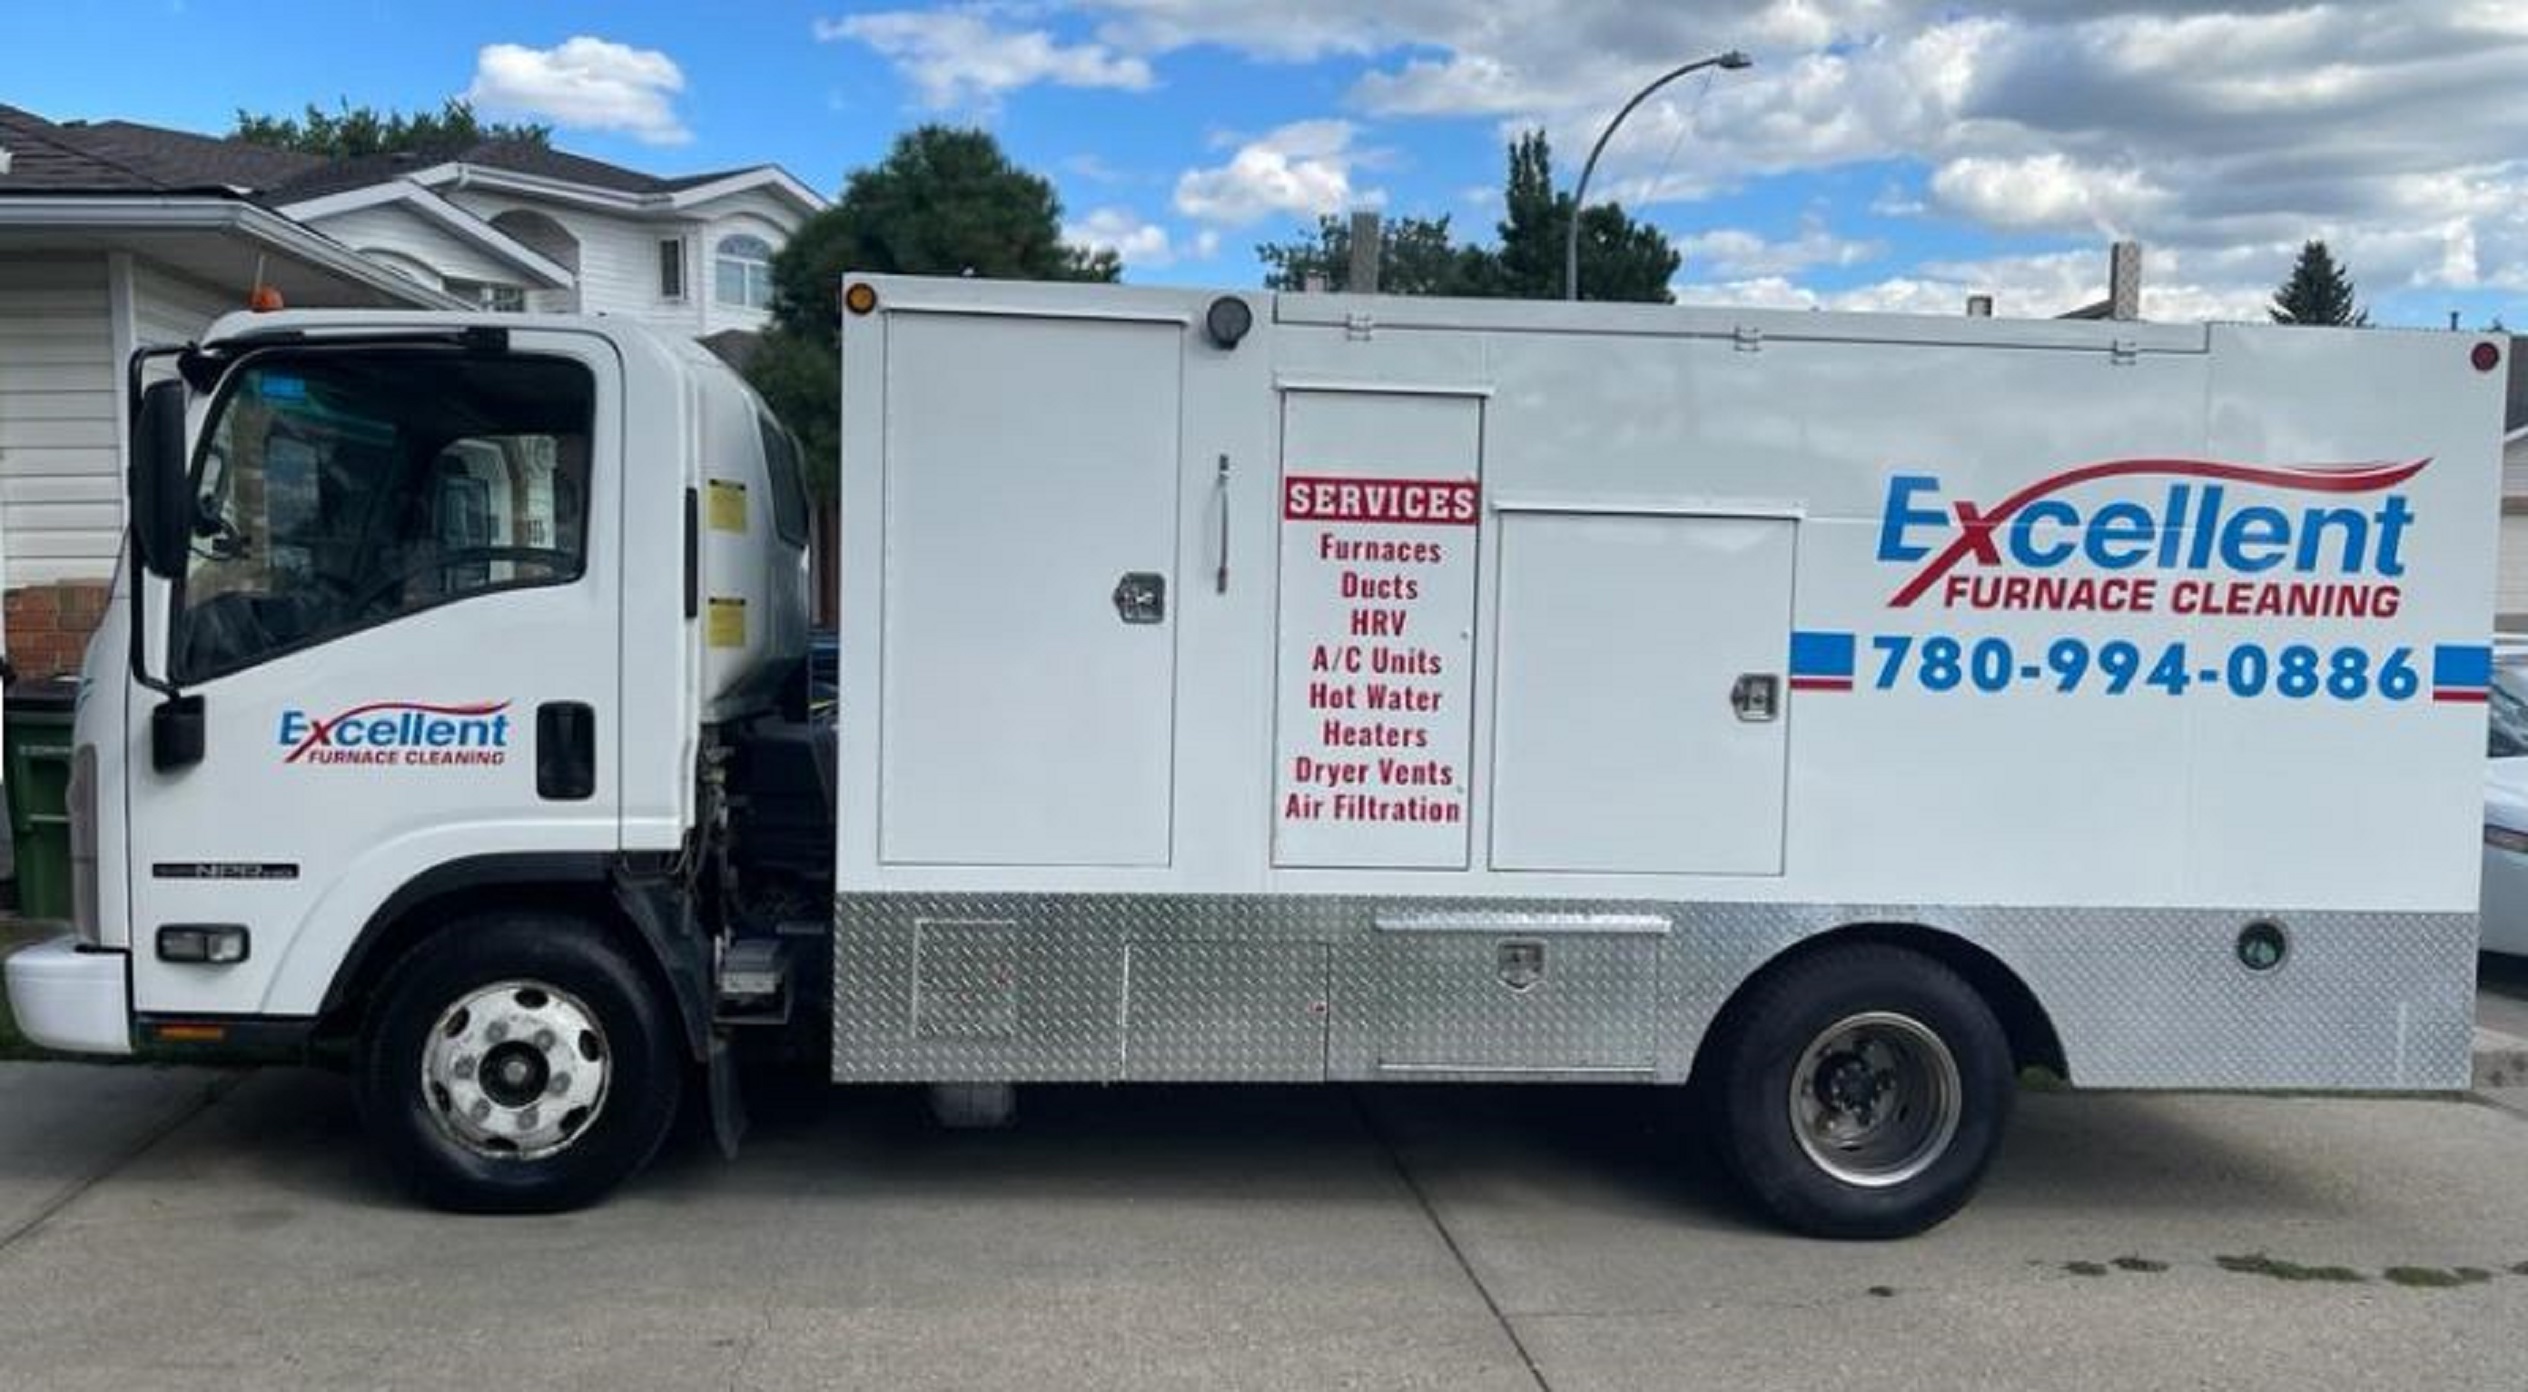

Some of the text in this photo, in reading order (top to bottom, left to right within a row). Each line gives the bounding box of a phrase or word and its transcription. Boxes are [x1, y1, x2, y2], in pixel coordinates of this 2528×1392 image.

[1288, 483, 1476, 520] SERVICES
[1319, 532, 1442, 564] Furnaces
[1877, 474, 2414, 607] Excellent
[1341, 570, 1419, 601] Ducts
[1943, 576, 2403, 618] FURNACE CLEANING
[1350, 608, 1407, 637] HRV
[1312, 644, 1442, 676] A/C Units
[1873, 635, 2420, 701] 780-994-0886
[1309, 681, 1443, 712] Hot Water
[279, 710, 509, 762] Excellent
[1323, 719, 1428, 748] Heaters
[308, 749, 505, 766] FURNACE CLEANING
[1295, 755, 1453, 788] Dryer Vents
[1285, 792, 1460, 823] Air Filtration
